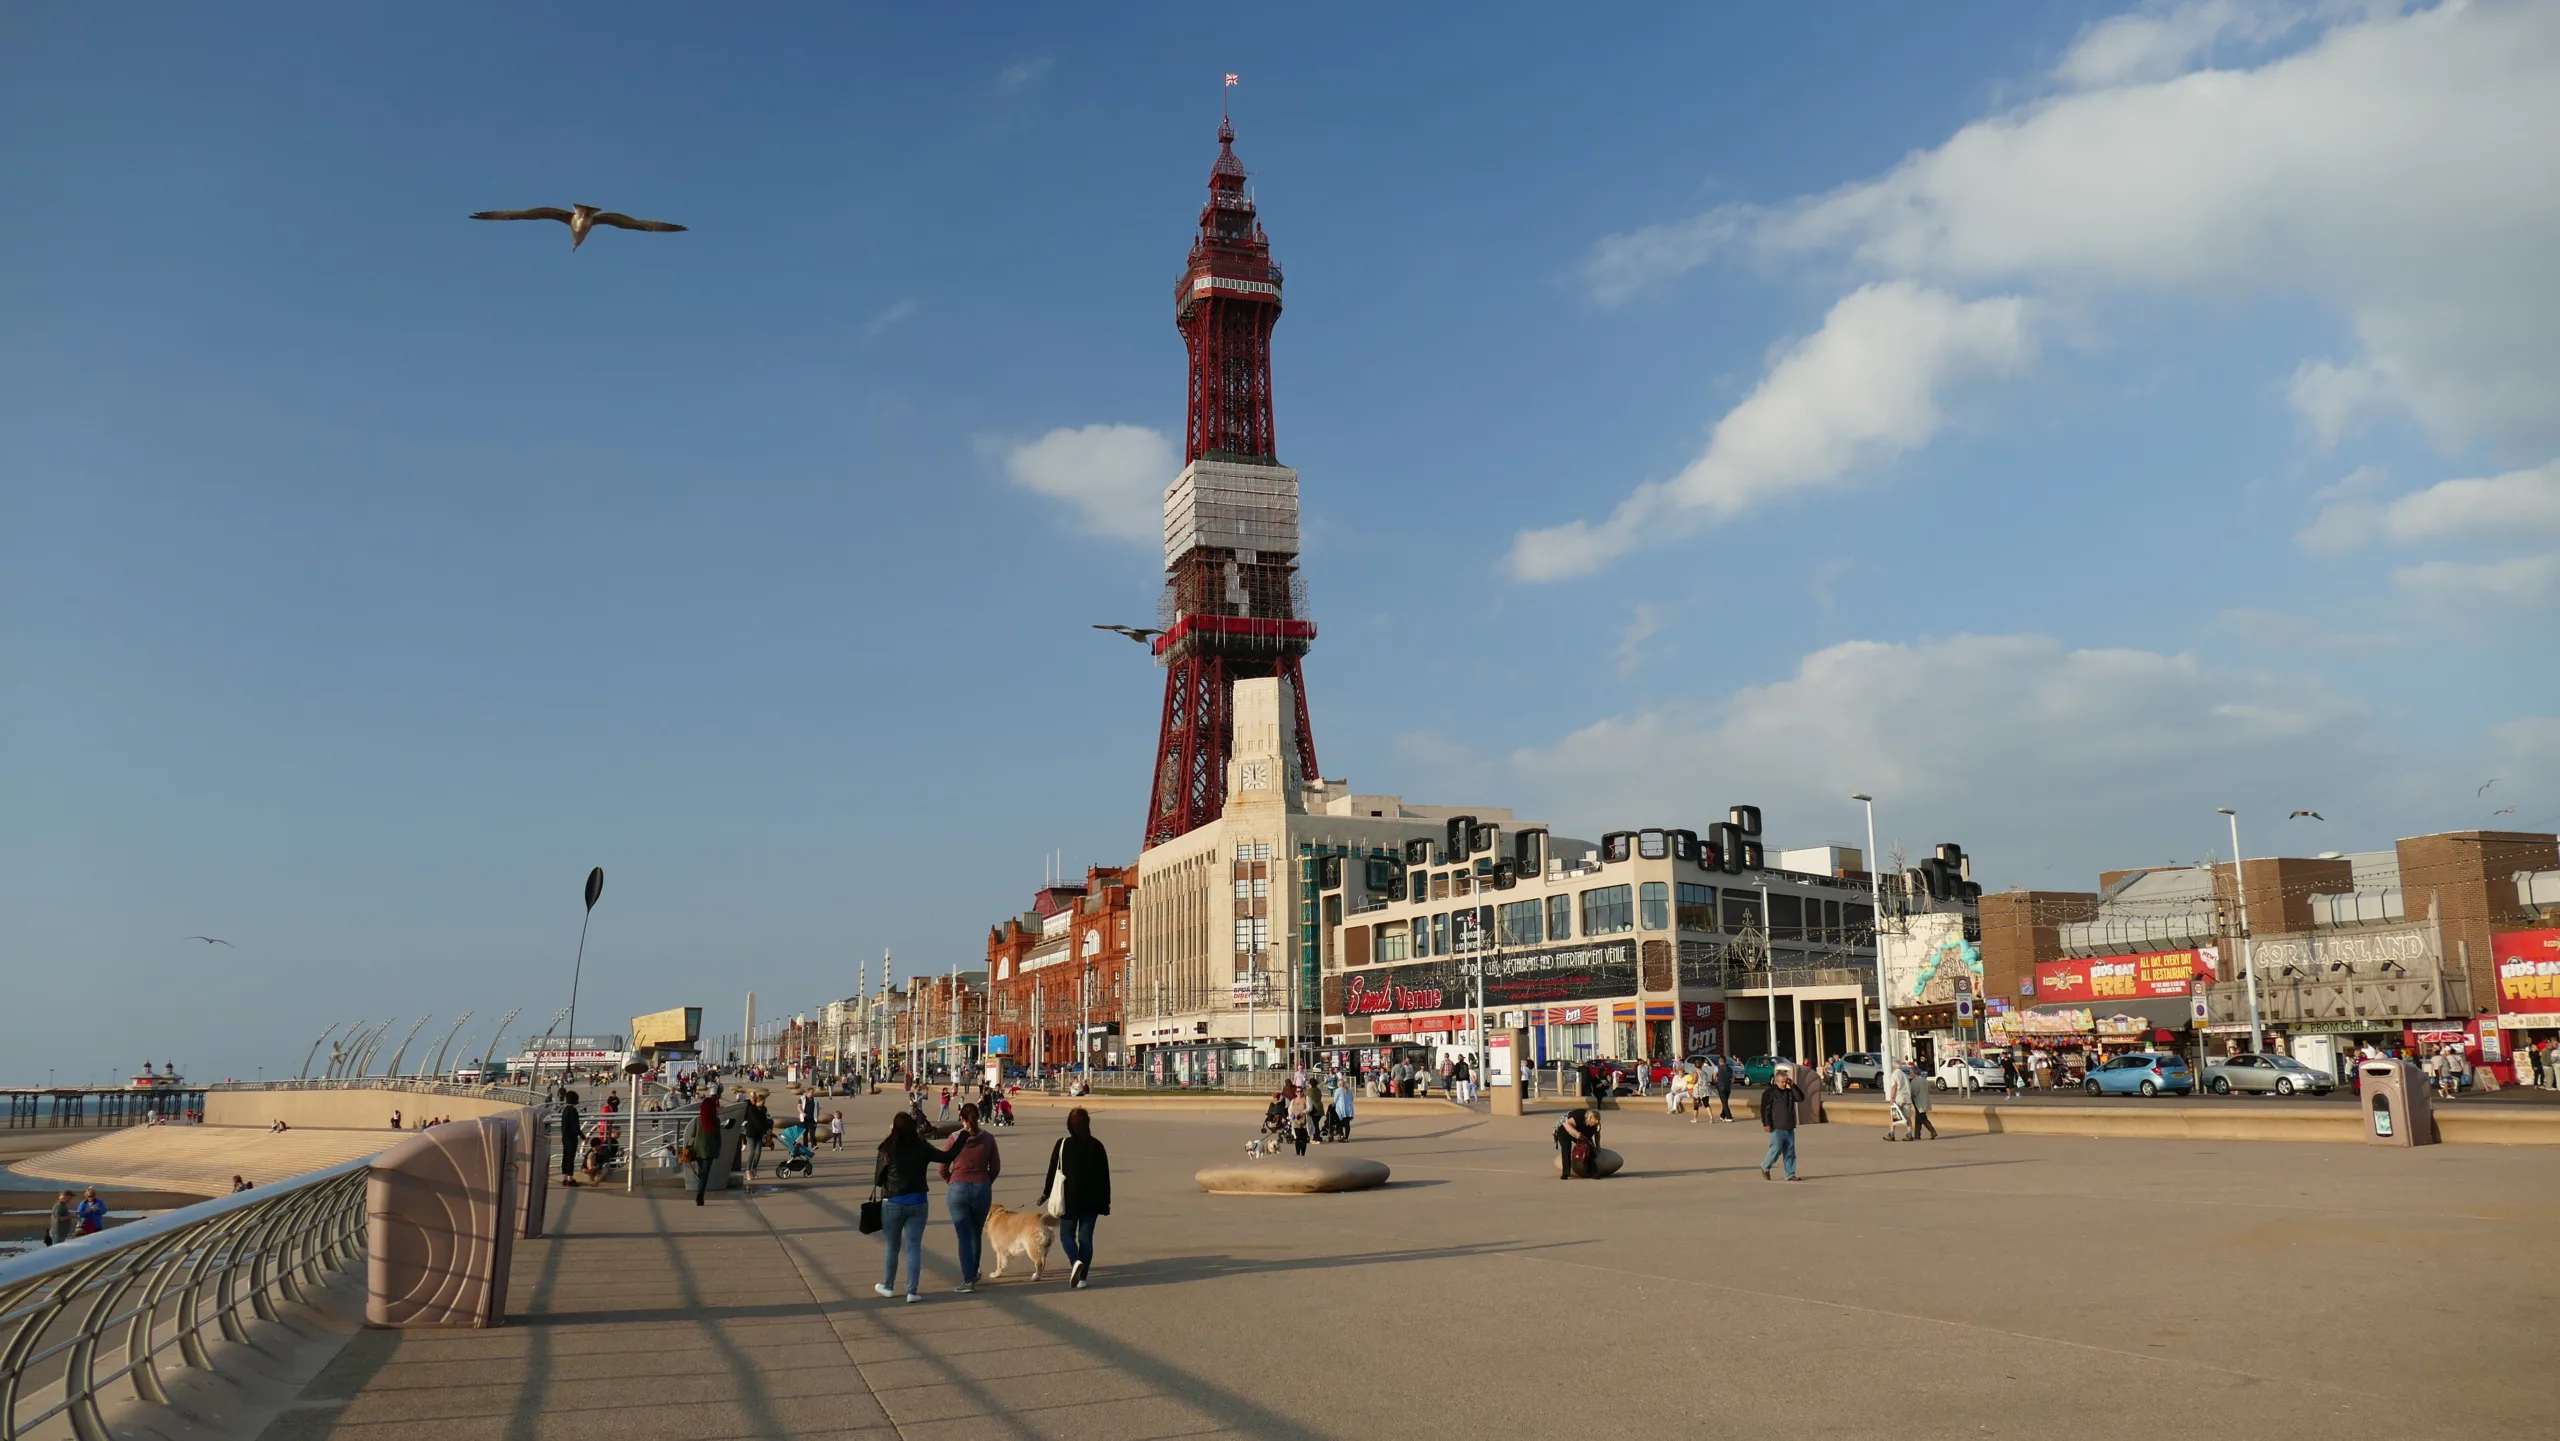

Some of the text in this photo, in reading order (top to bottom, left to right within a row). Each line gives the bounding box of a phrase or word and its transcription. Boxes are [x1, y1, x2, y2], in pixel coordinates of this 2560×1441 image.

[2256, 935, 2424, 968] CORAL ISLAND
[1502, 956, 1539, 976] RESTAURANT
[1540, 955, 1553, 970] AND
[1556, 949, 1604, 968] ENTERTAINMENT
[1605, 946, 1625, 963] VENUE
[2140, 957, 2149, 968] ALL
[2163, 954, 2180, 966] EVERY
[2181, 953, 2192, 965] DAY
[2090, 963, 2136, 978] KIDS EAT
[2141, 966, 2192, 982] ALL RESTAURANTS
[2500, 961, 2536, 978] KIDS
[2090, 974, 2137, 996] FREE
[1395, 986, 1441, 1010] Venue
[2310, 1023, 2339, 1033] PROM
[2525, 1016, 2551, 1027] HAND
